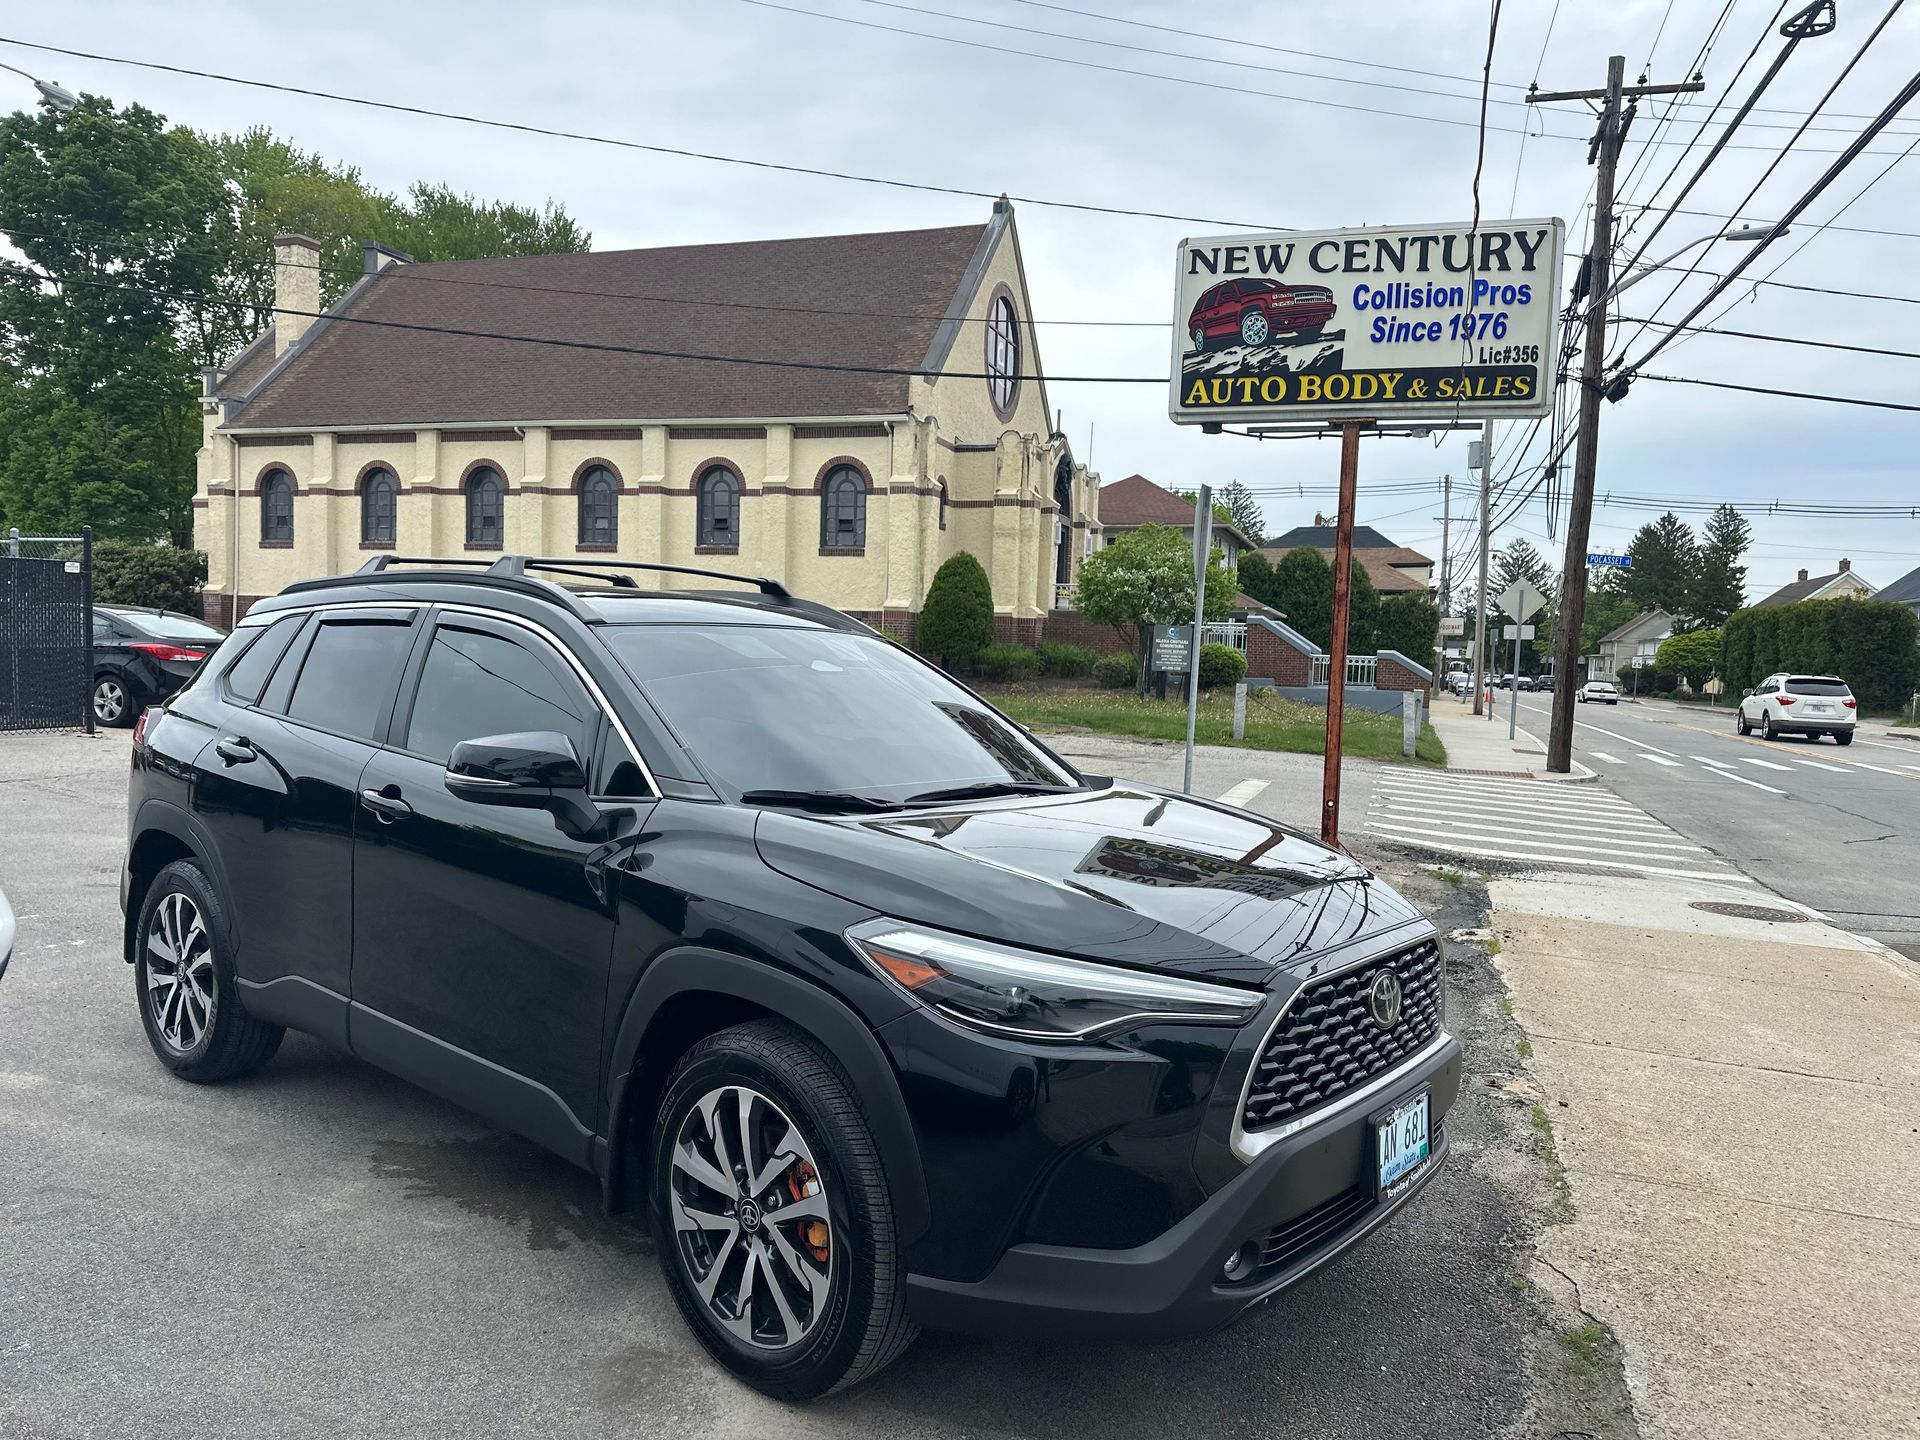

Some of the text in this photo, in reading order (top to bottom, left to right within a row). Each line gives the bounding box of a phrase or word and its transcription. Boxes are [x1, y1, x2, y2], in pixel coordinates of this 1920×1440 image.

[1188, 229, 1548, 274] NEW CENTURY
[1353, 279, 1531, 310] Collision Pros
[1370, 312, 1509, 343] Since 1976
[1479, 345, 1539, 364] Lic#356
[1185, 372, 1531, 404] AUTO BODY & SALES
[1590, 555, 1622, 565] POCASSET
[1383, 1123, 1398, 1166] AN
[1404, 1106, 1426, 1150] 681
[1386, 1181, 1405, 1198] Toyota
